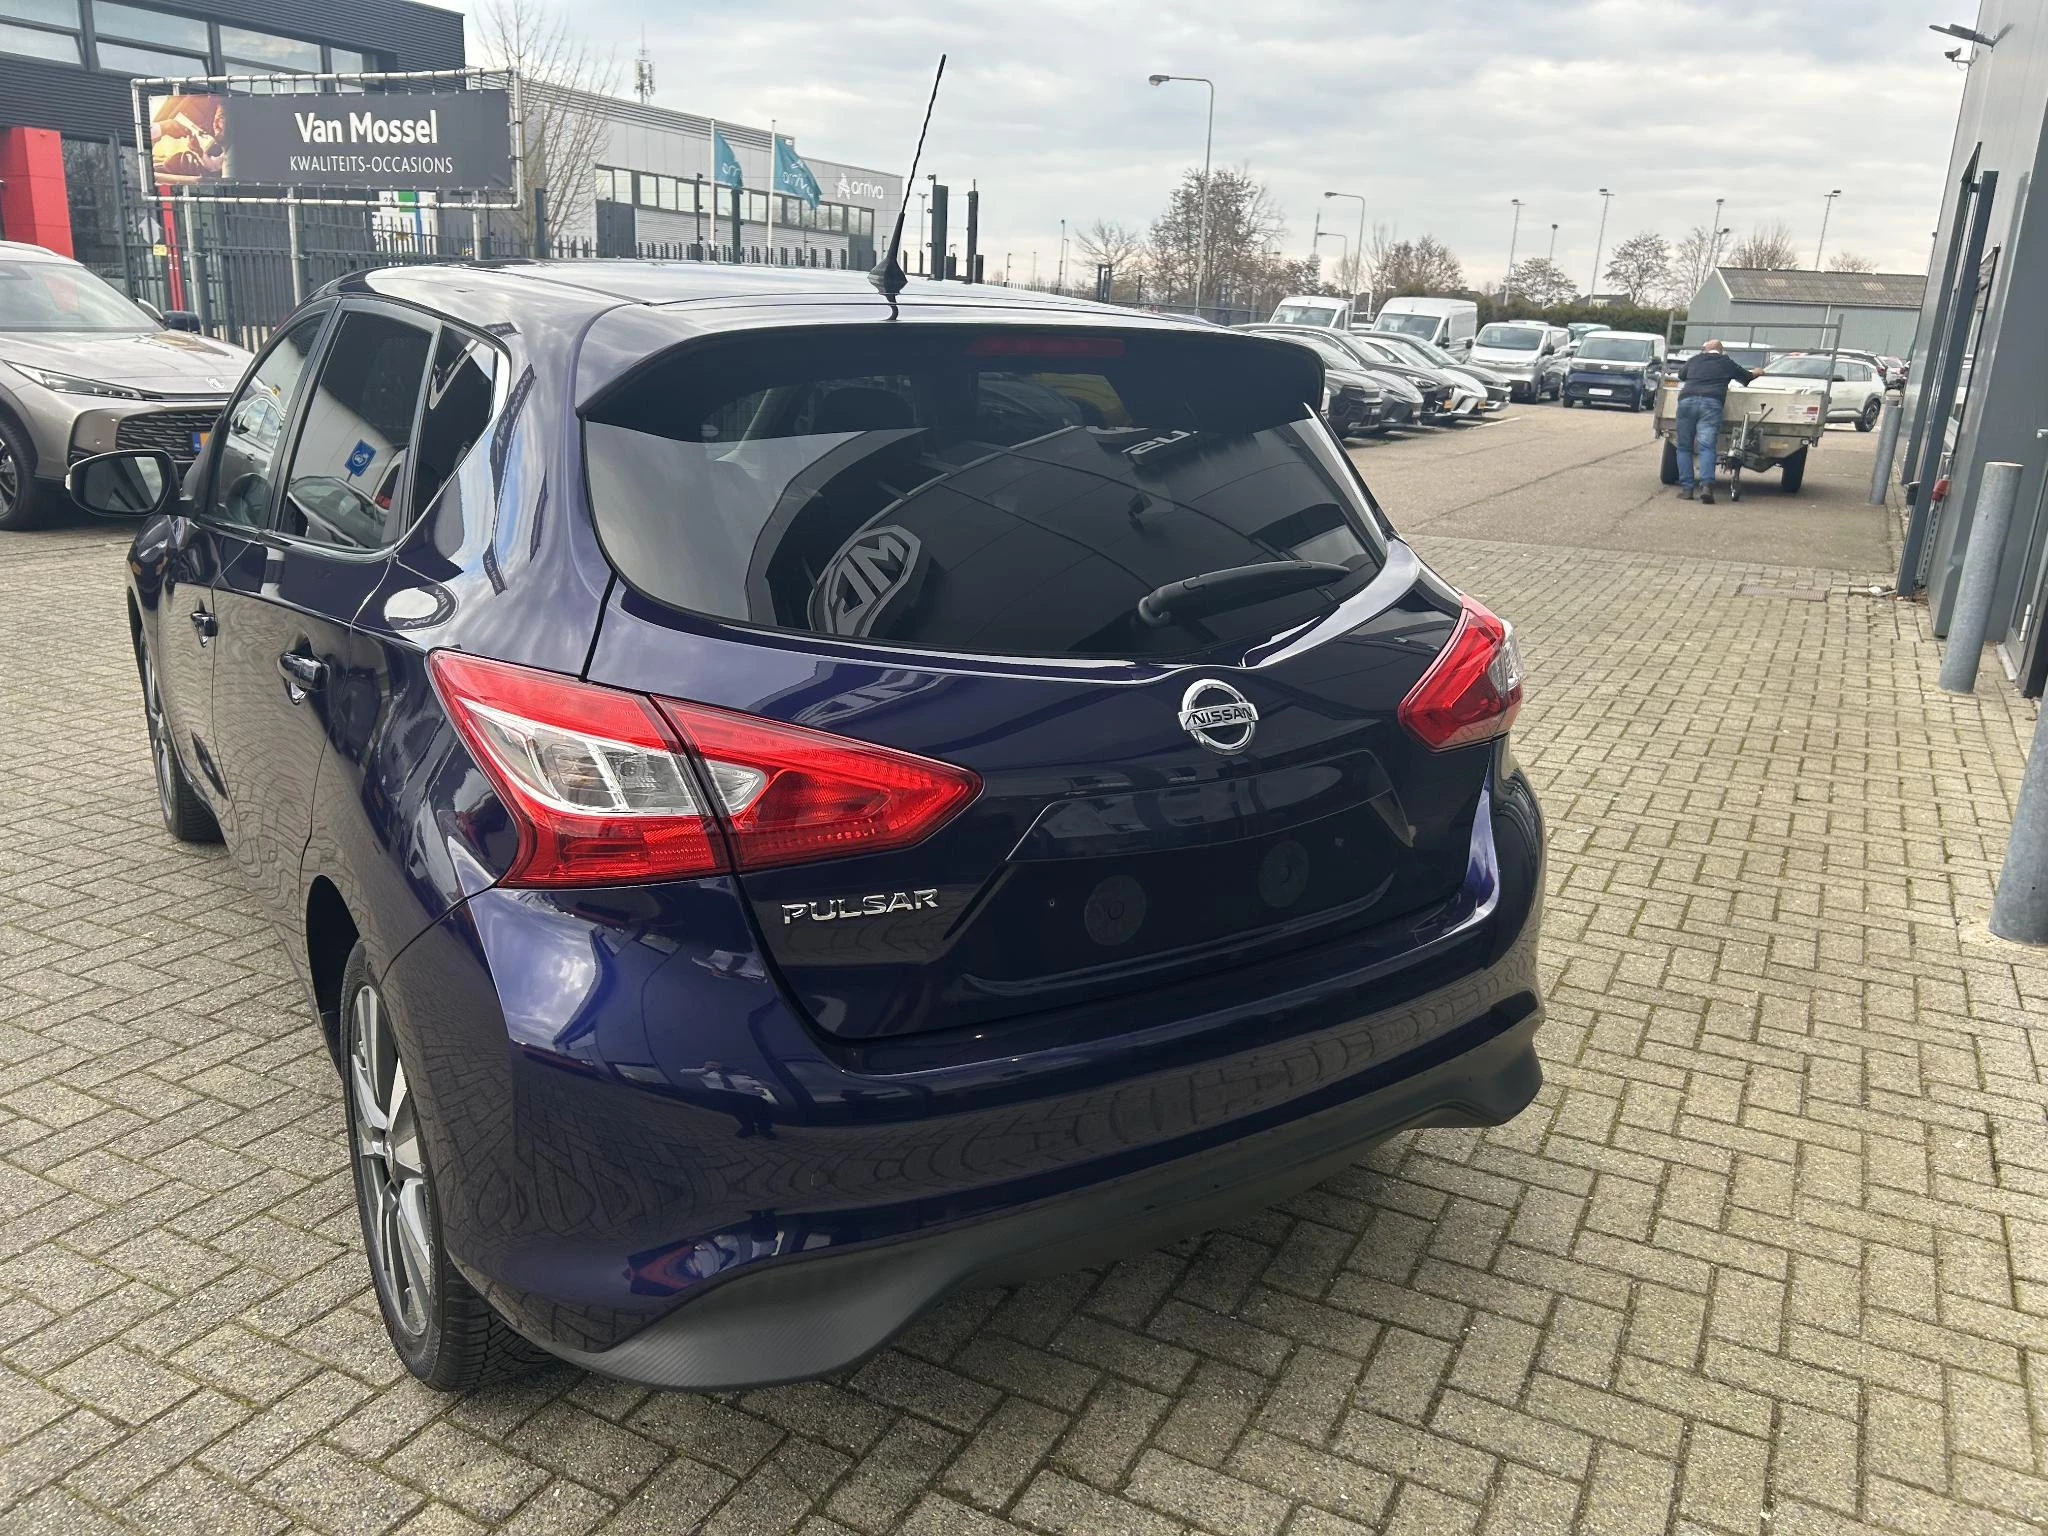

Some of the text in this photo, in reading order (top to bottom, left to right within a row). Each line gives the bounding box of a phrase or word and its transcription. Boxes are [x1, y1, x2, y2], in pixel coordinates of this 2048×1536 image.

[294, 109, 438, 144] Van Mossel
[289, 155, 453, 174] KWALITEITS-OCCASIONS
[851, 181, 884, 199] arriva
[1192, 706, 1253, 725] NISSAN
[781, 888, 939, 925] PULSAR
